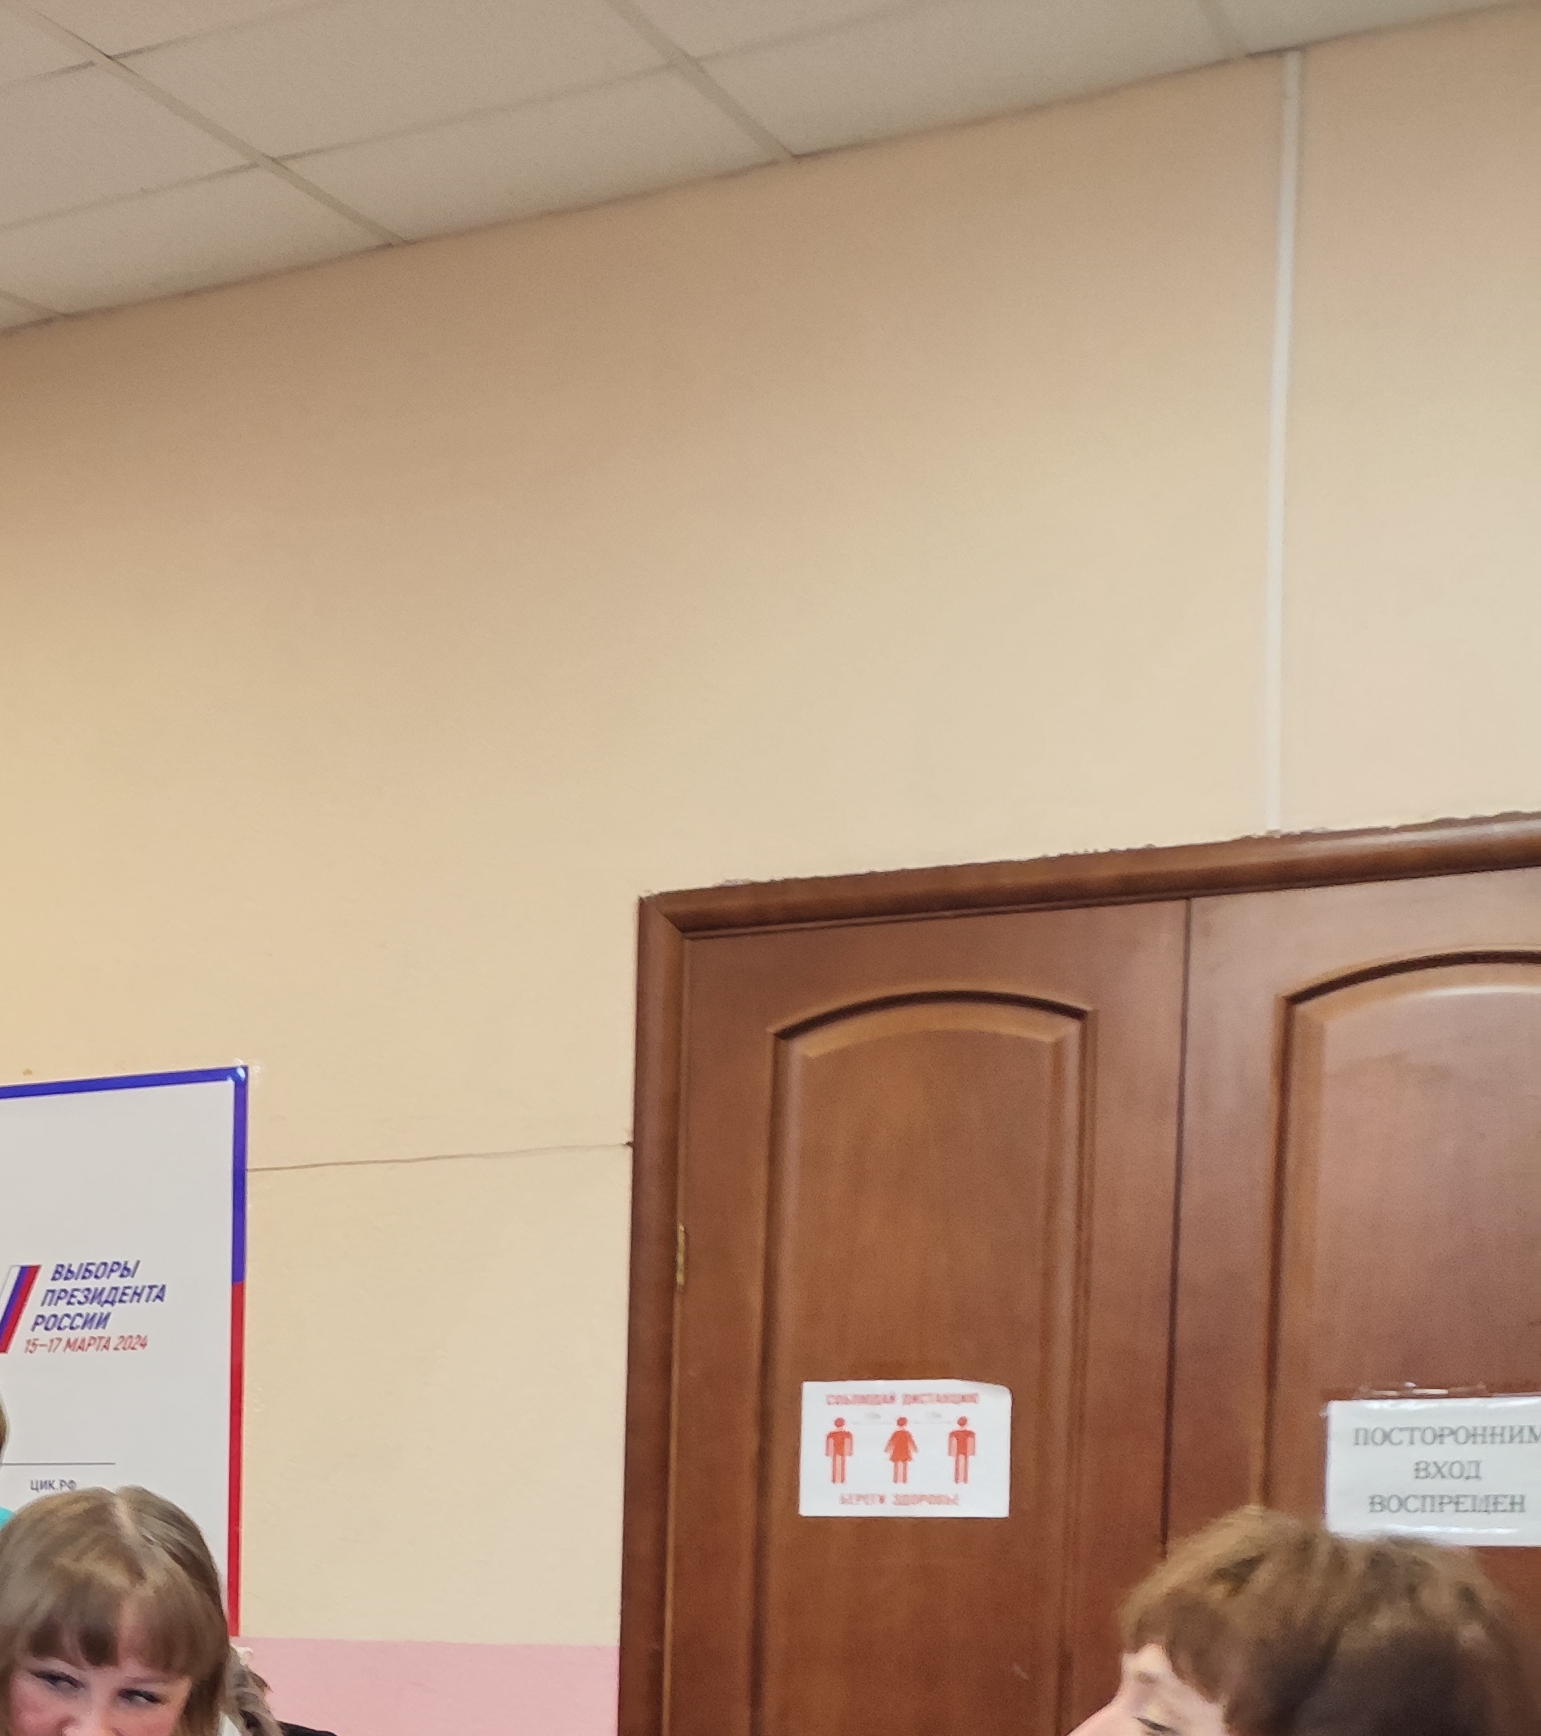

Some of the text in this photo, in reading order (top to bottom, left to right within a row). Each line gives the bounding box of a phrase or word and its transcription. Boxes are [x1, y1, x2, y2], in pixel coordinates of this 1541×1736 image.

[51, 1260, 141, 1282] ВЫБОРЫ
[40, 1284, 167, 1308] ПРЕЗИДЕНТА
[30, 1312, 111, 1332] РОССИИ
[63, 1336, 112, 1353] МАРТА
[114, 1334, 149, 1351] 2024
[1414, 1460, 1483, 1480] ВХОД
[29, 1479, 77, 1492] ЦИК.РФ
[1369, 1494, 1527, 1514] ВОСПРЕЩЕН
